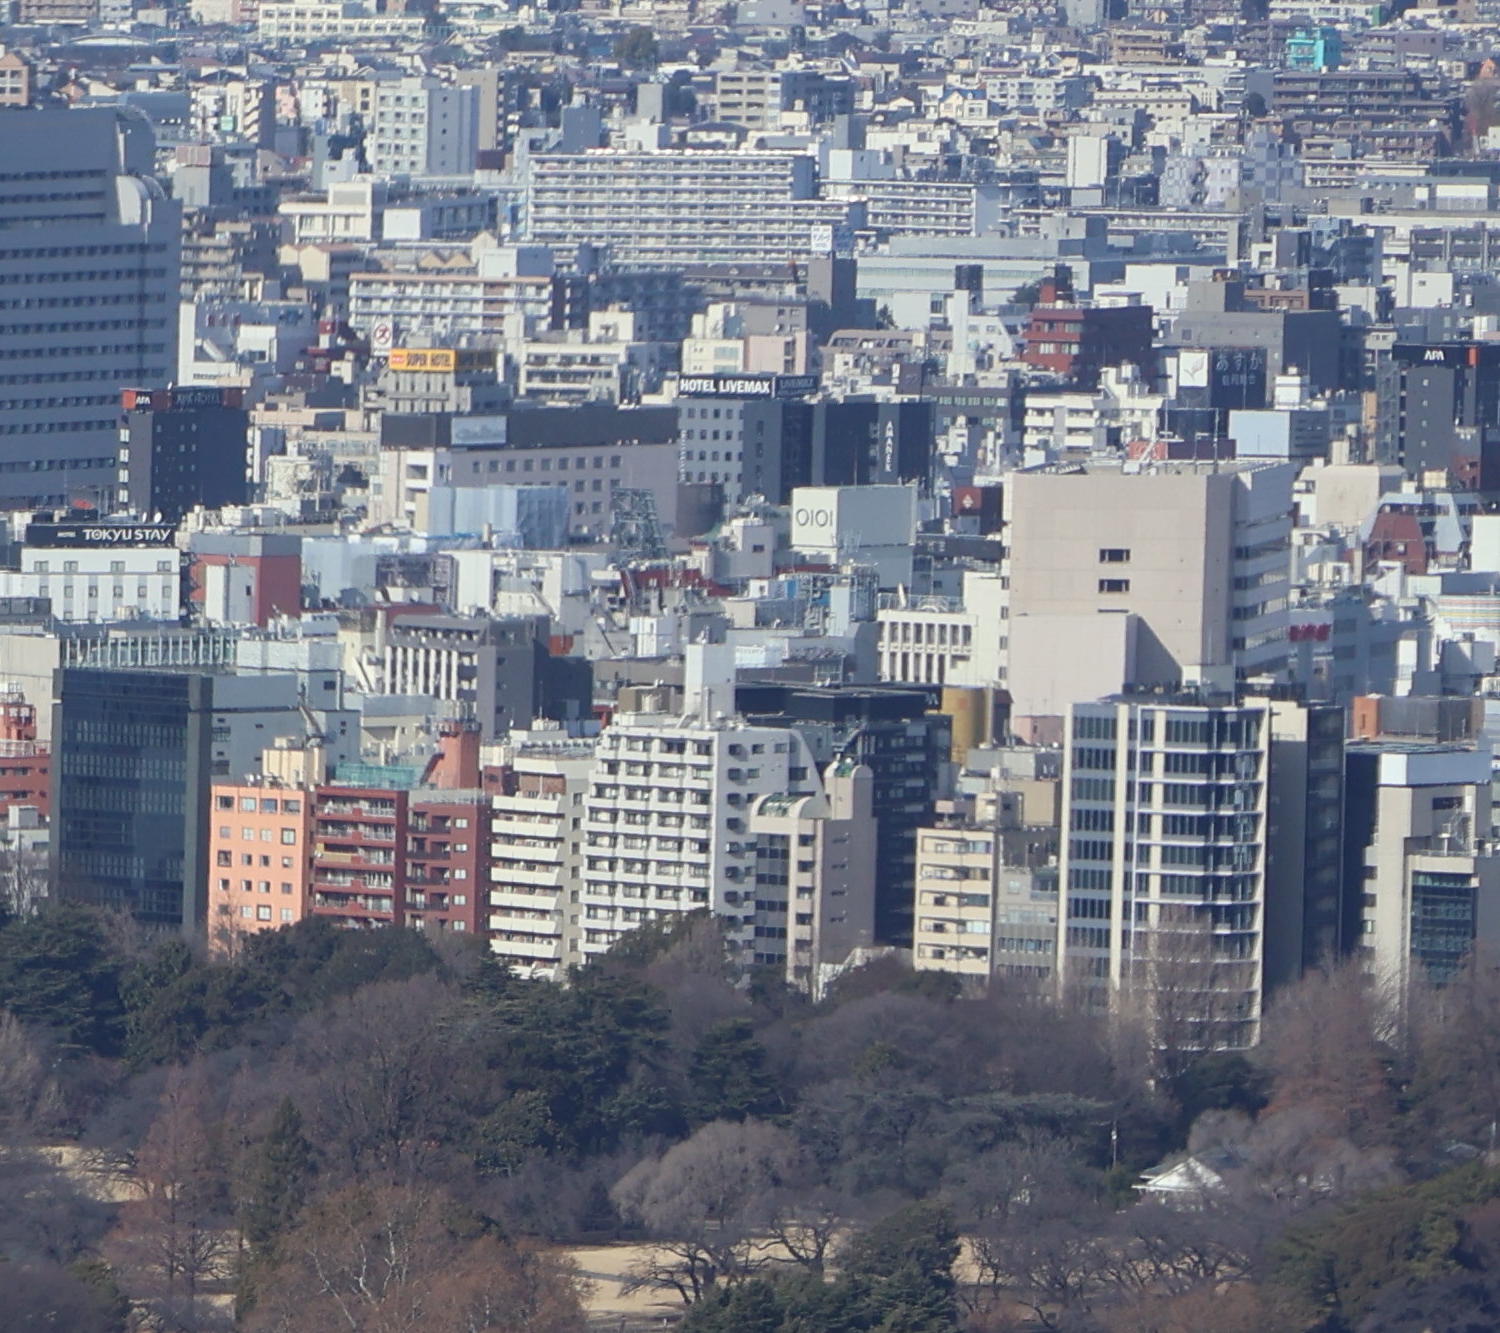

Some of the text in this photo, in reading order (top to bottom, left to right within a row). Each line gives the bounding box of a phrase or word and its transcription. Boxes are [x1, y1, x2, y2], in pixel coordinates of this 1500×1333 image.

[1423, 350, 1445, 361] APA
[680, 378, 770, 394] HOTEL LIVEMAX
[135, 395, 151, 405] APA
[82, 528, 133, 542] TOKYU
[134, 528, 171, 542] STAY
